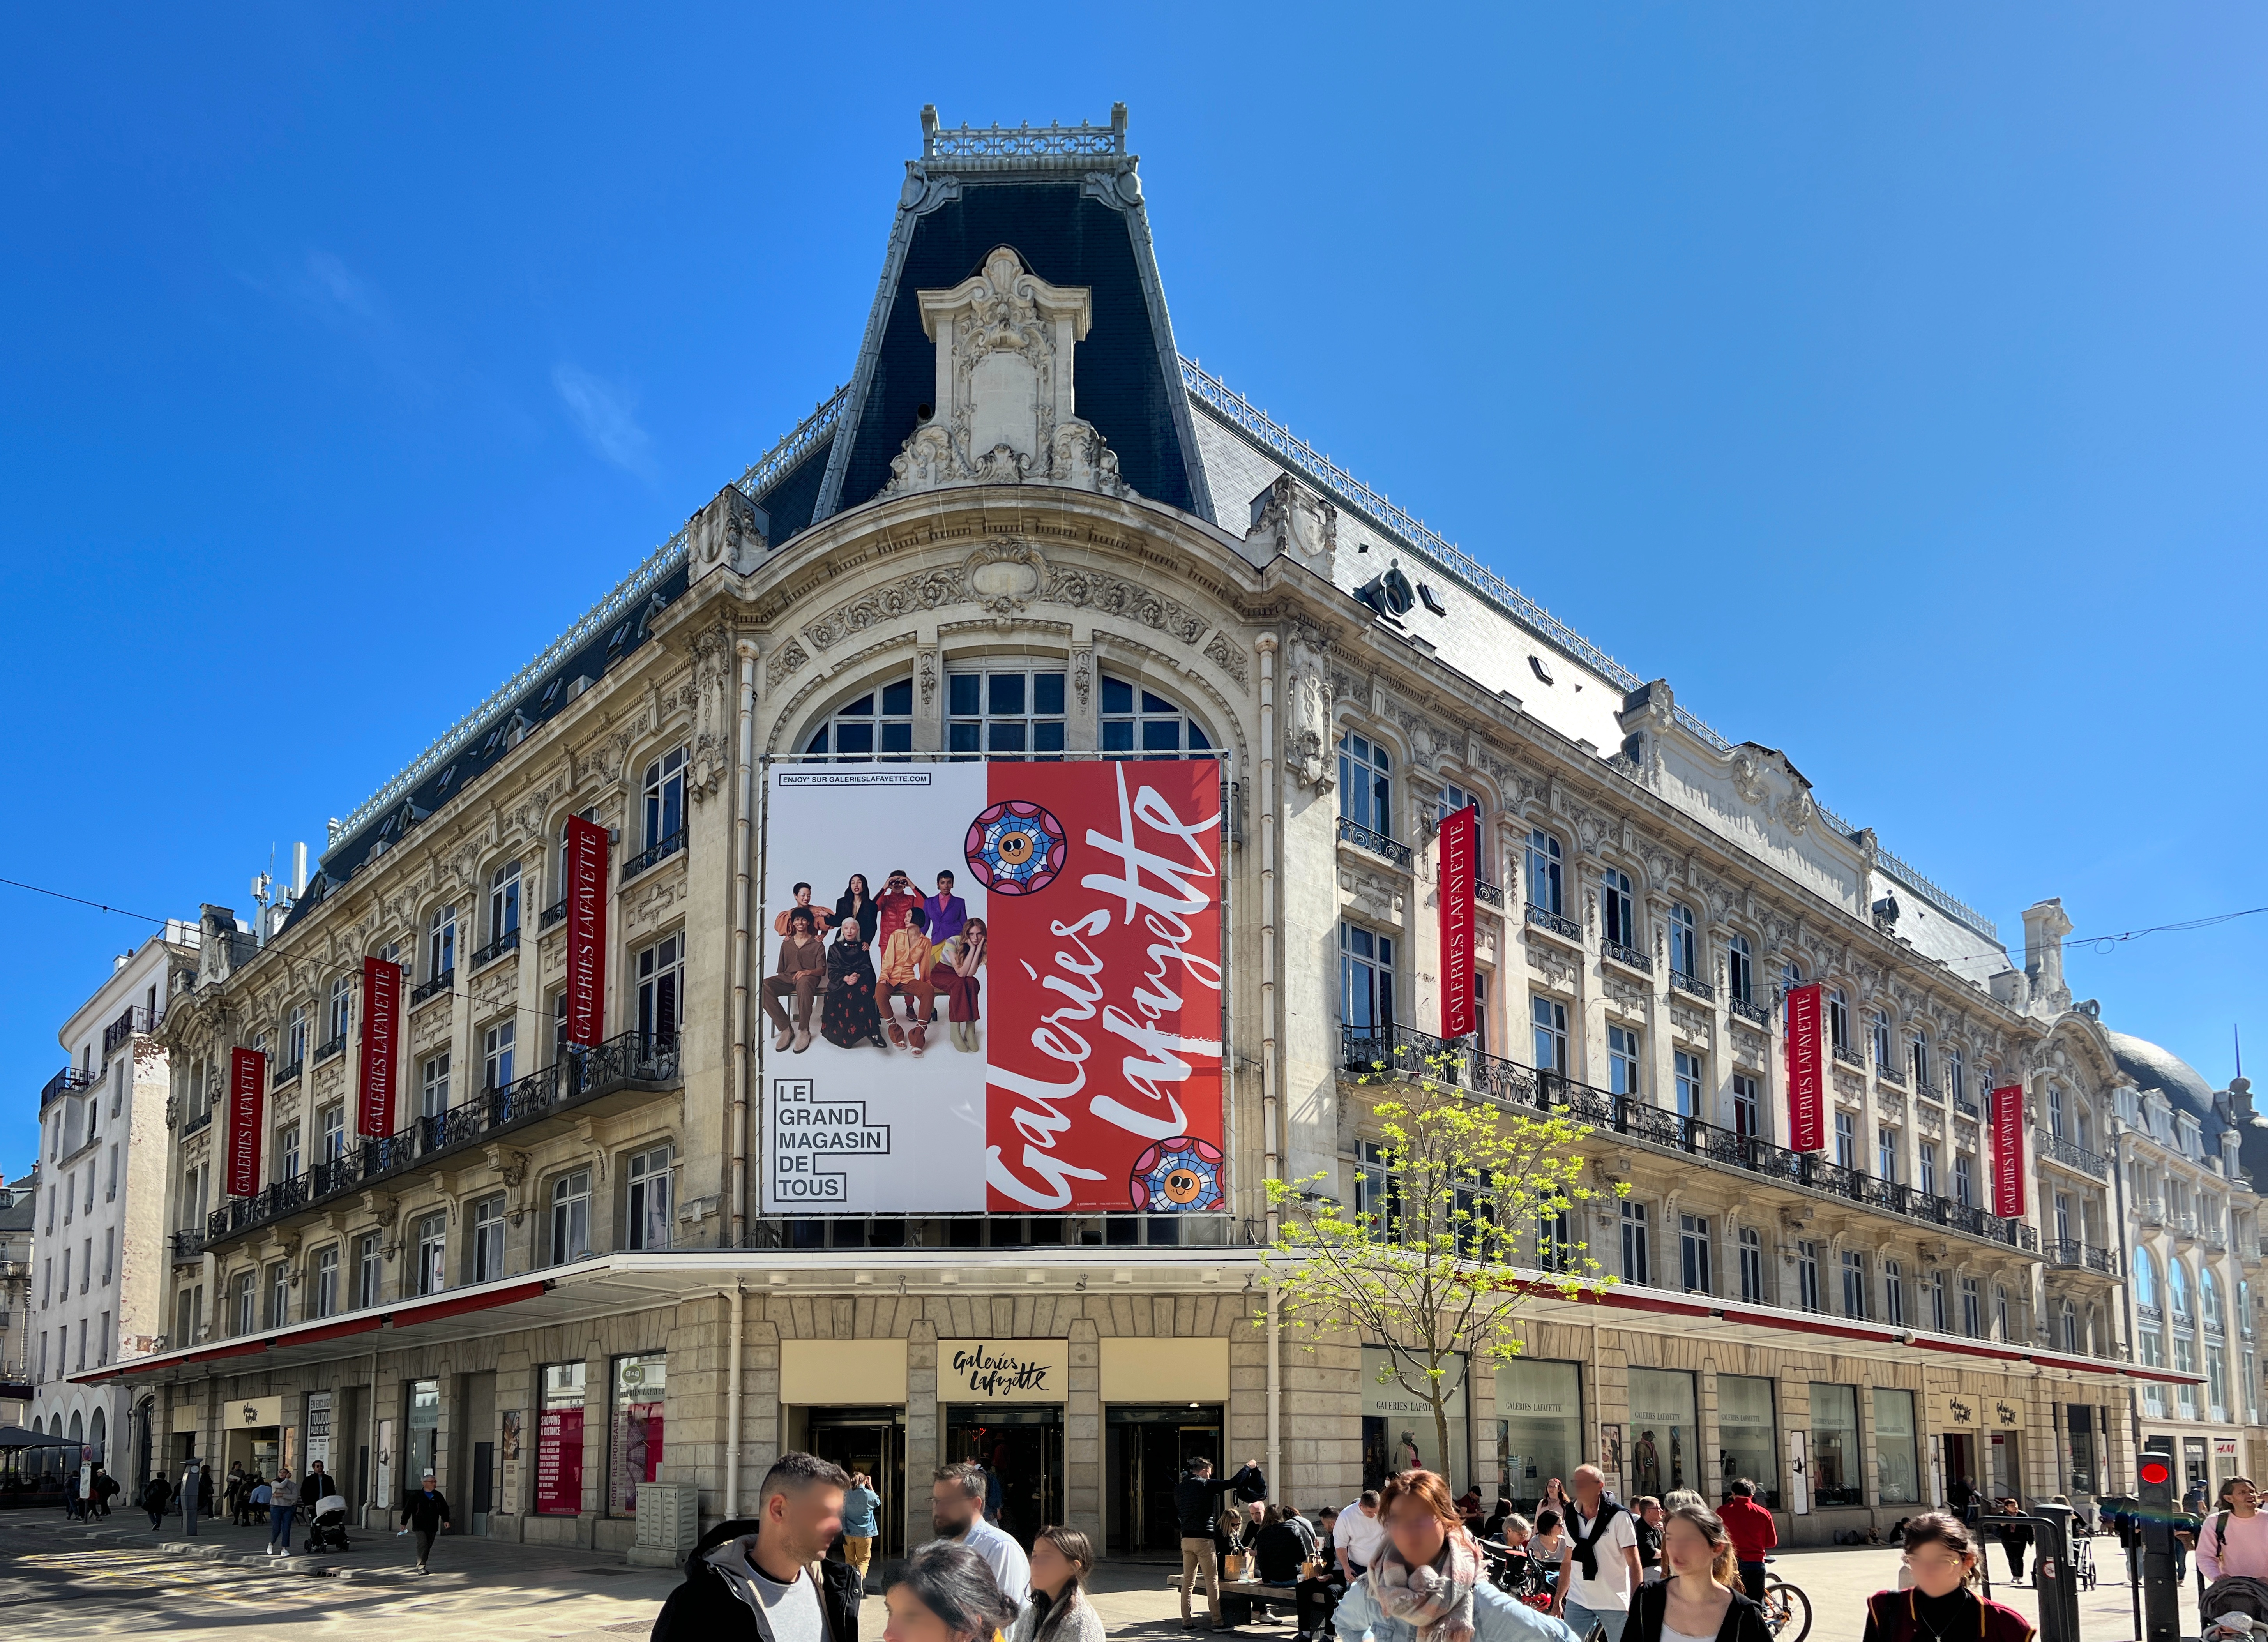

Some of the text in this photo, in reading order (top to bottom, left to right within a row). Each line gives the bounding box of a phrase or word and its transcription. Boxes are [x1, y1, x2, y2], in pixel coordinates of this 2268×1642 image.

[1450, 821, 1464, 1031] GALERIES LAFAYETTE
[575, 831, 596, 1038] GALERIES LAFAYETTE
[986, 761, 1222, 1209] Galeries Lafayette
[369, 969, 390, 1132] GALERIES LAFAYETTE
[1797, 994, 1814, 1147] GALERIES LAFAYETTE
[780, 1086, 806, 1102] LE
[237, 1056, 254, 1192] GALERIES LAFAYETTE
[779, 1109, 859, 1125] GRAND
[779, 1132, 880, 1148] MAGASIN
[2001, 1092, 2015, 1214] GALERIES LAFAYETTE
[779, 1156, 808, 1172] DE
[778, 1179, 838, 1196] TOUS
[953, 1345, 1018, 1376] Galeries
[970, 1362, 1052, 1396] Lafayette
[1376, 1400, 1434, 1411] GALERIES LAFAYE
[1506, 1402, 1561, 1412] GALERIES LAFAYETTE
[311, 1412, 329, 1425] TOUJOU
[541, 1415, 560, 1426] SHOPPING
[1635, 1411, 1680, 1421] GALERIES LAFAYETTE
[544, 1427, 560, 1436] DISTANCE
[2217, 1444, 2234, 1453] H&M
